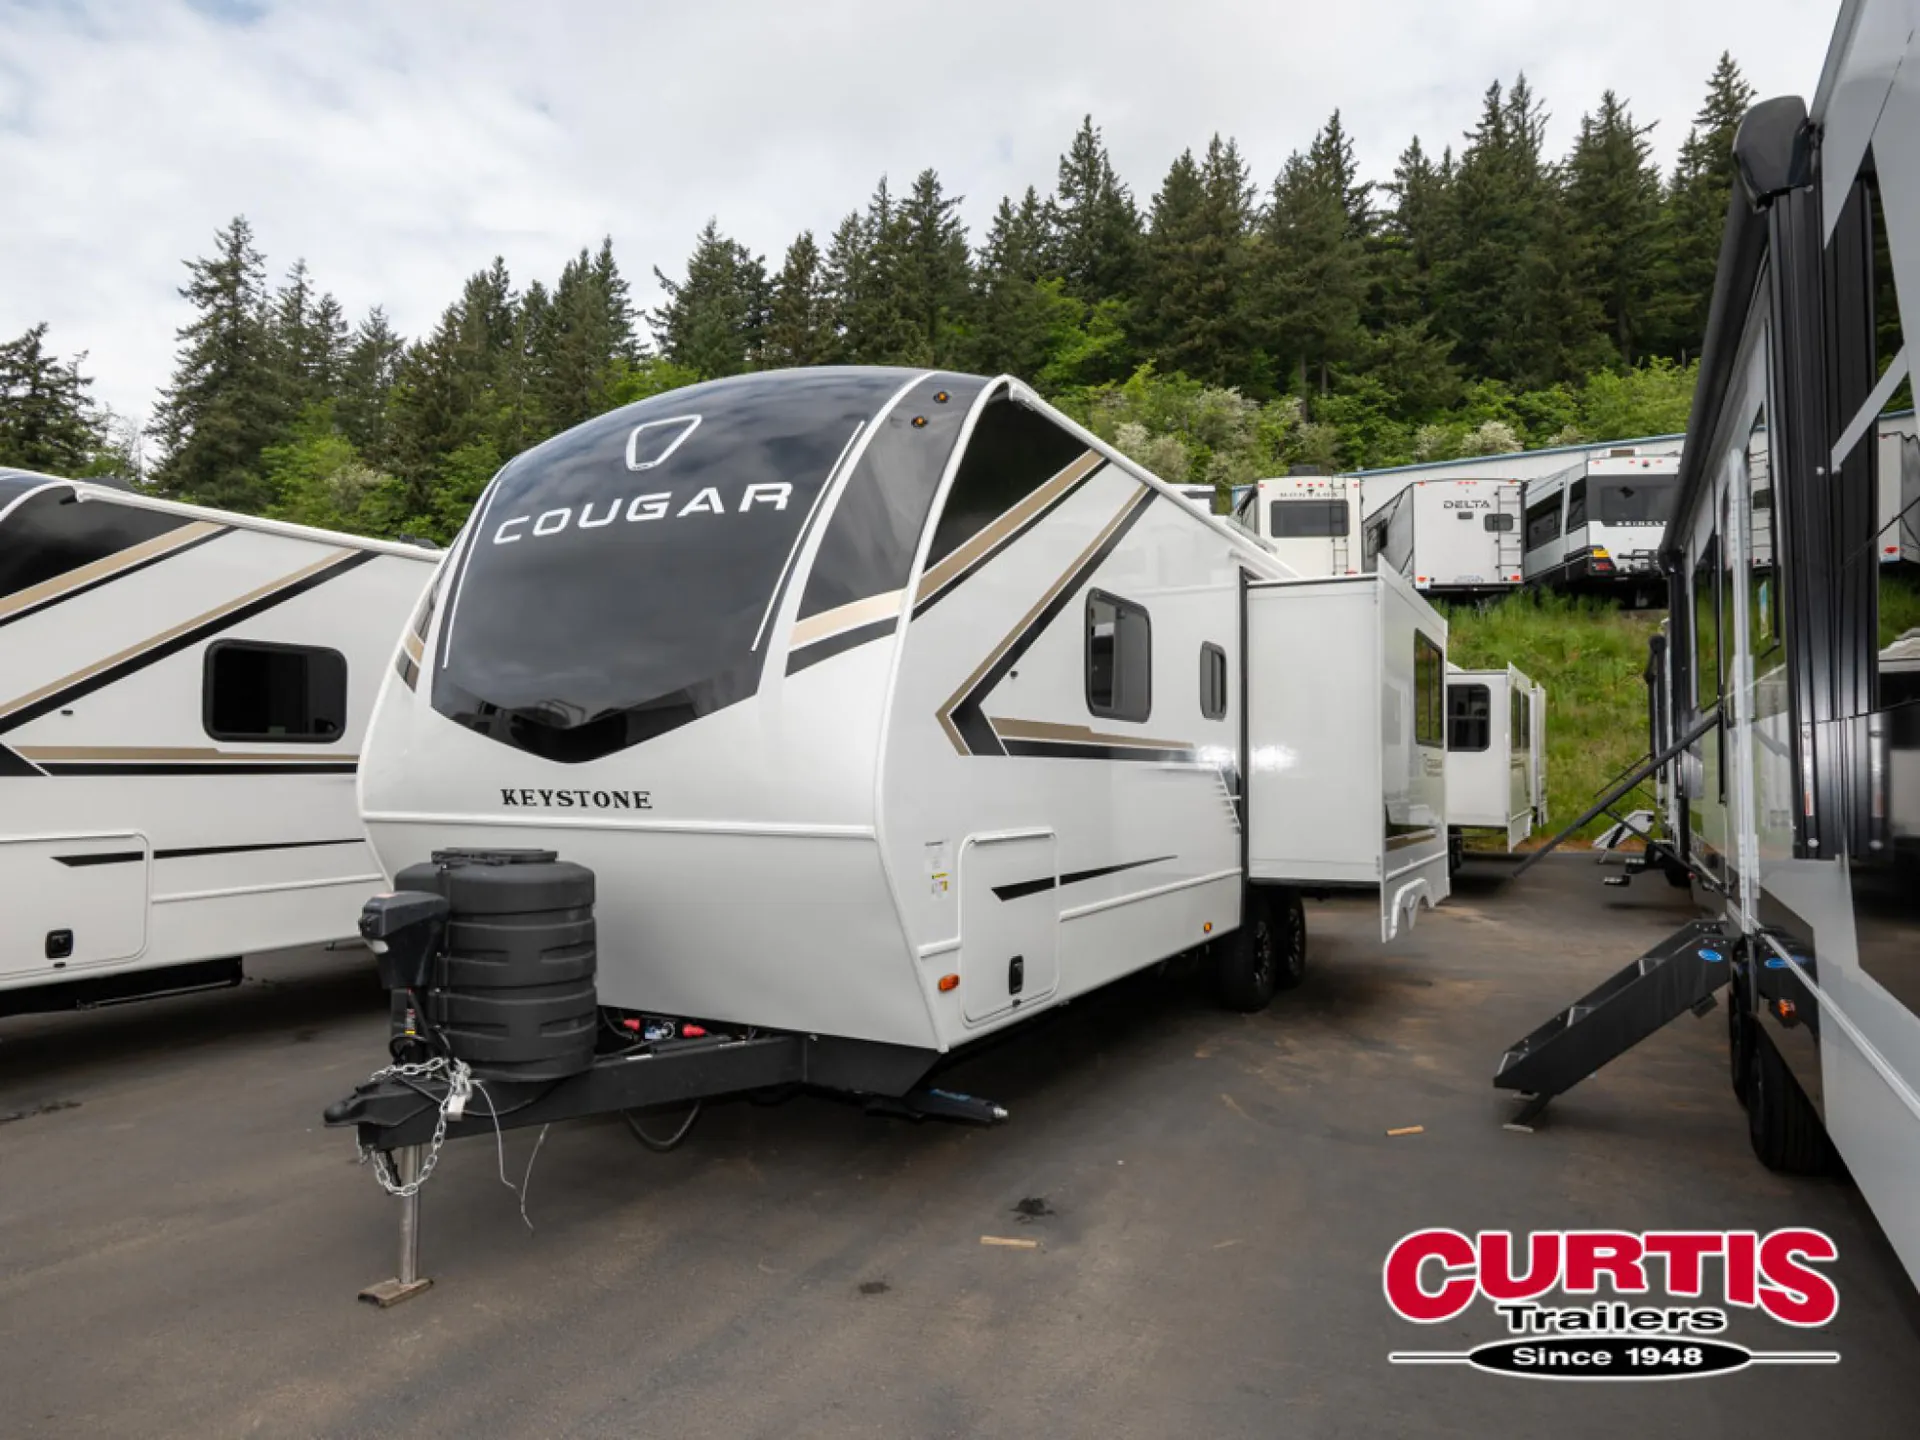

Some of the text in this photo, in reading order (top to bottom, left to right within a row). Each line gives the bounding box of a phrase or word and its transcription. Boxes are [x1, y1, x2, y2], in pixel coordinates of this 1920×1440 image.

[493, 481, 793, 545] COUGAR
[1443, 500, 1490, 509] DELTA
[501, 788, 653, 809] KEYSTONE
